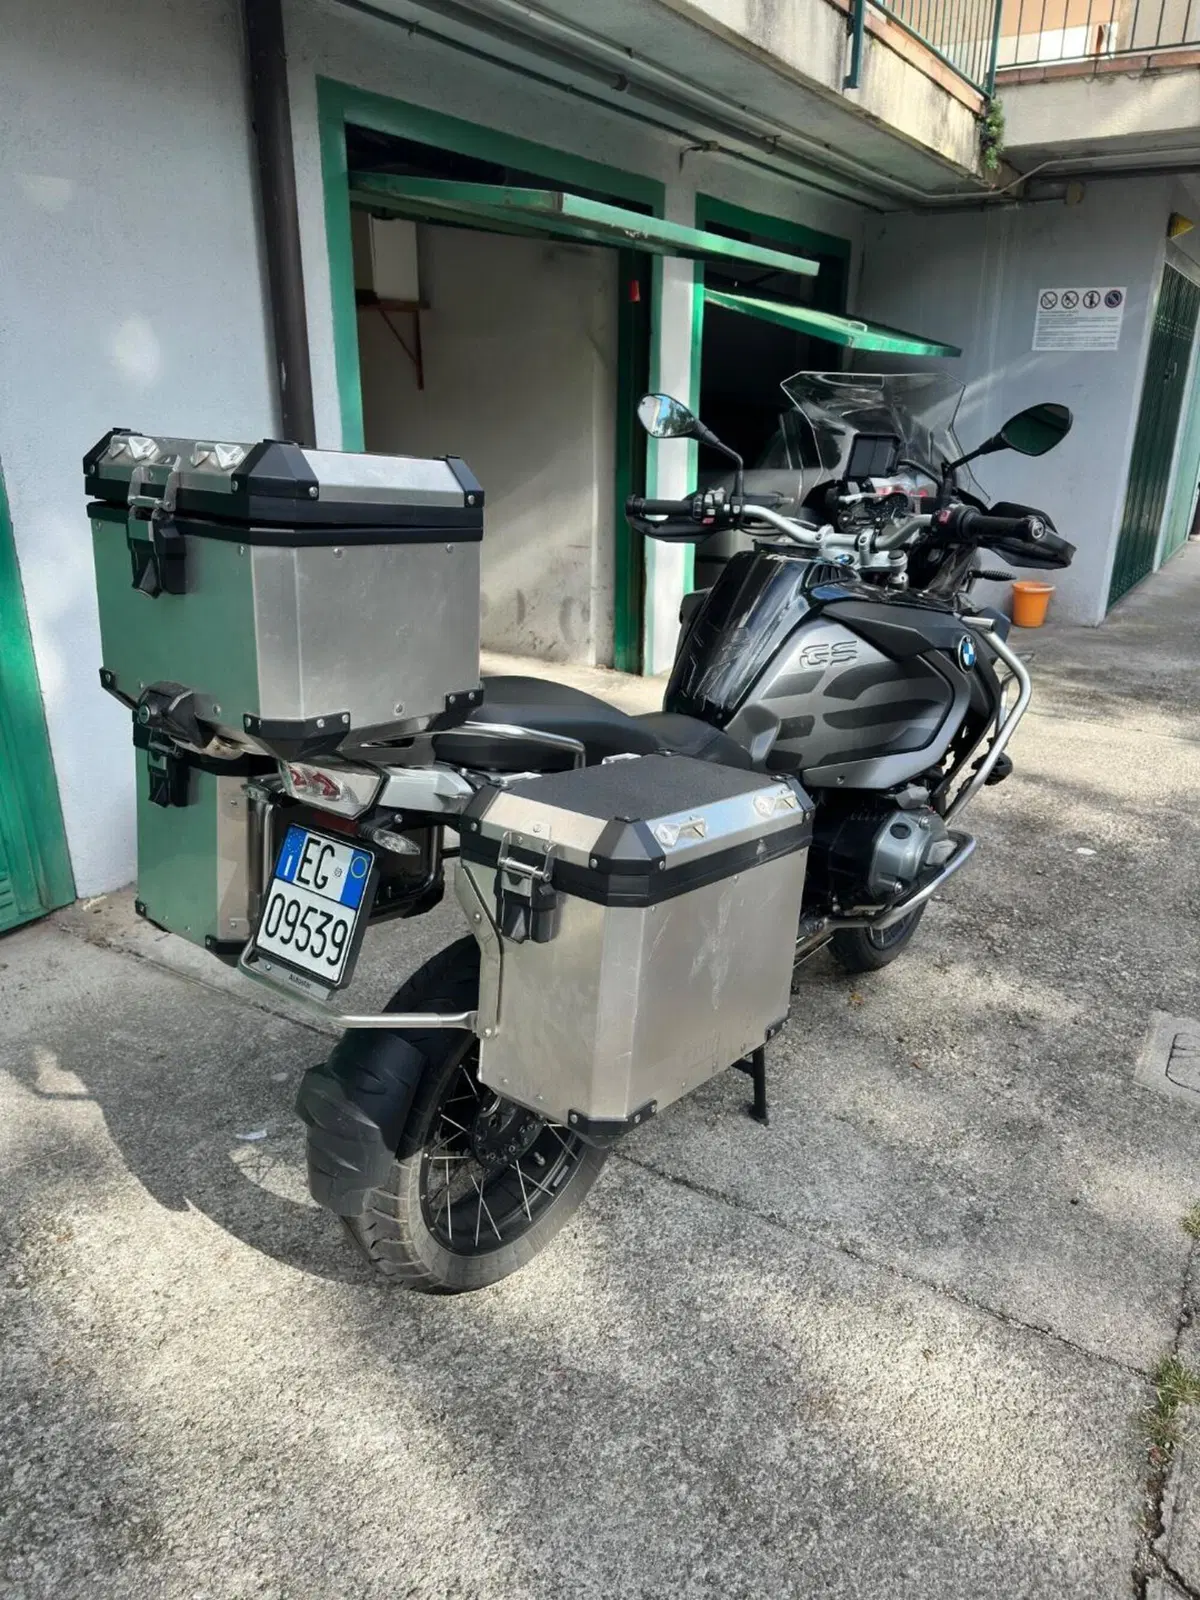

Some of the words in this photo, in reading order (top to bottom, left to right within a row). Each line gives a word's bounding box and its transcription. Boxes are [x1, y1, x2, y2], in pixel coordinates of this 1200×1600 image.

[799, 640, 858, 669] GS
[296, 837, 335, 890] EG
[264, 893, 349, 966] 09539
